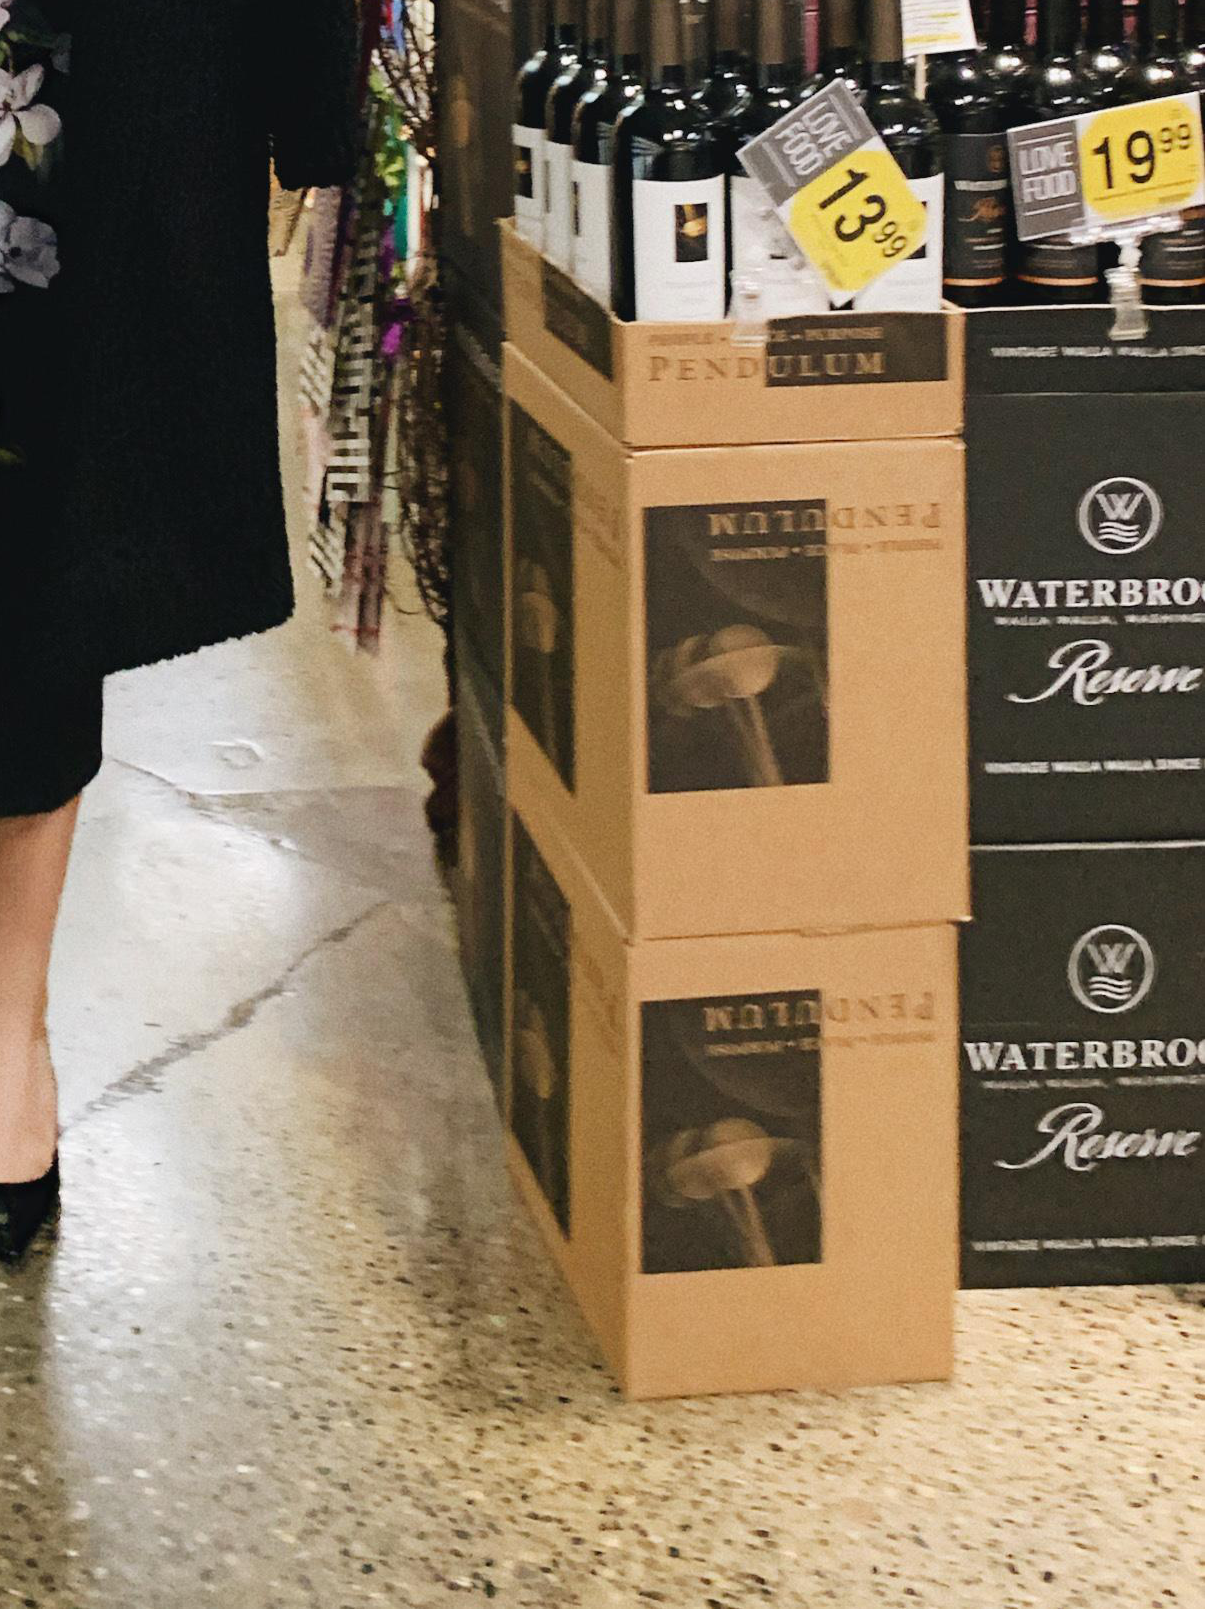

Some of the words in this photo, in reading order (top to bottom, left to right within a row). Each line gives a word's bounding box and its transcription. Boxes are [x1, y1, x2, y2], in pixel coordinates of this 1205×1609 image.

[801, 100, 854, 159] LOVE
[774, 121, 827, 177] FOOD
[1017, 139, 1075, 176] LOVE
[1020, 169, 1078, 204] FOOD
[647, 351, 886, 382] PENDULUM
[706, 502, 942, 536] PENDULUM
[976, 577, 1205, 609] WATERBRO
[963, 1038, 1205, 1073] WATERBRO
